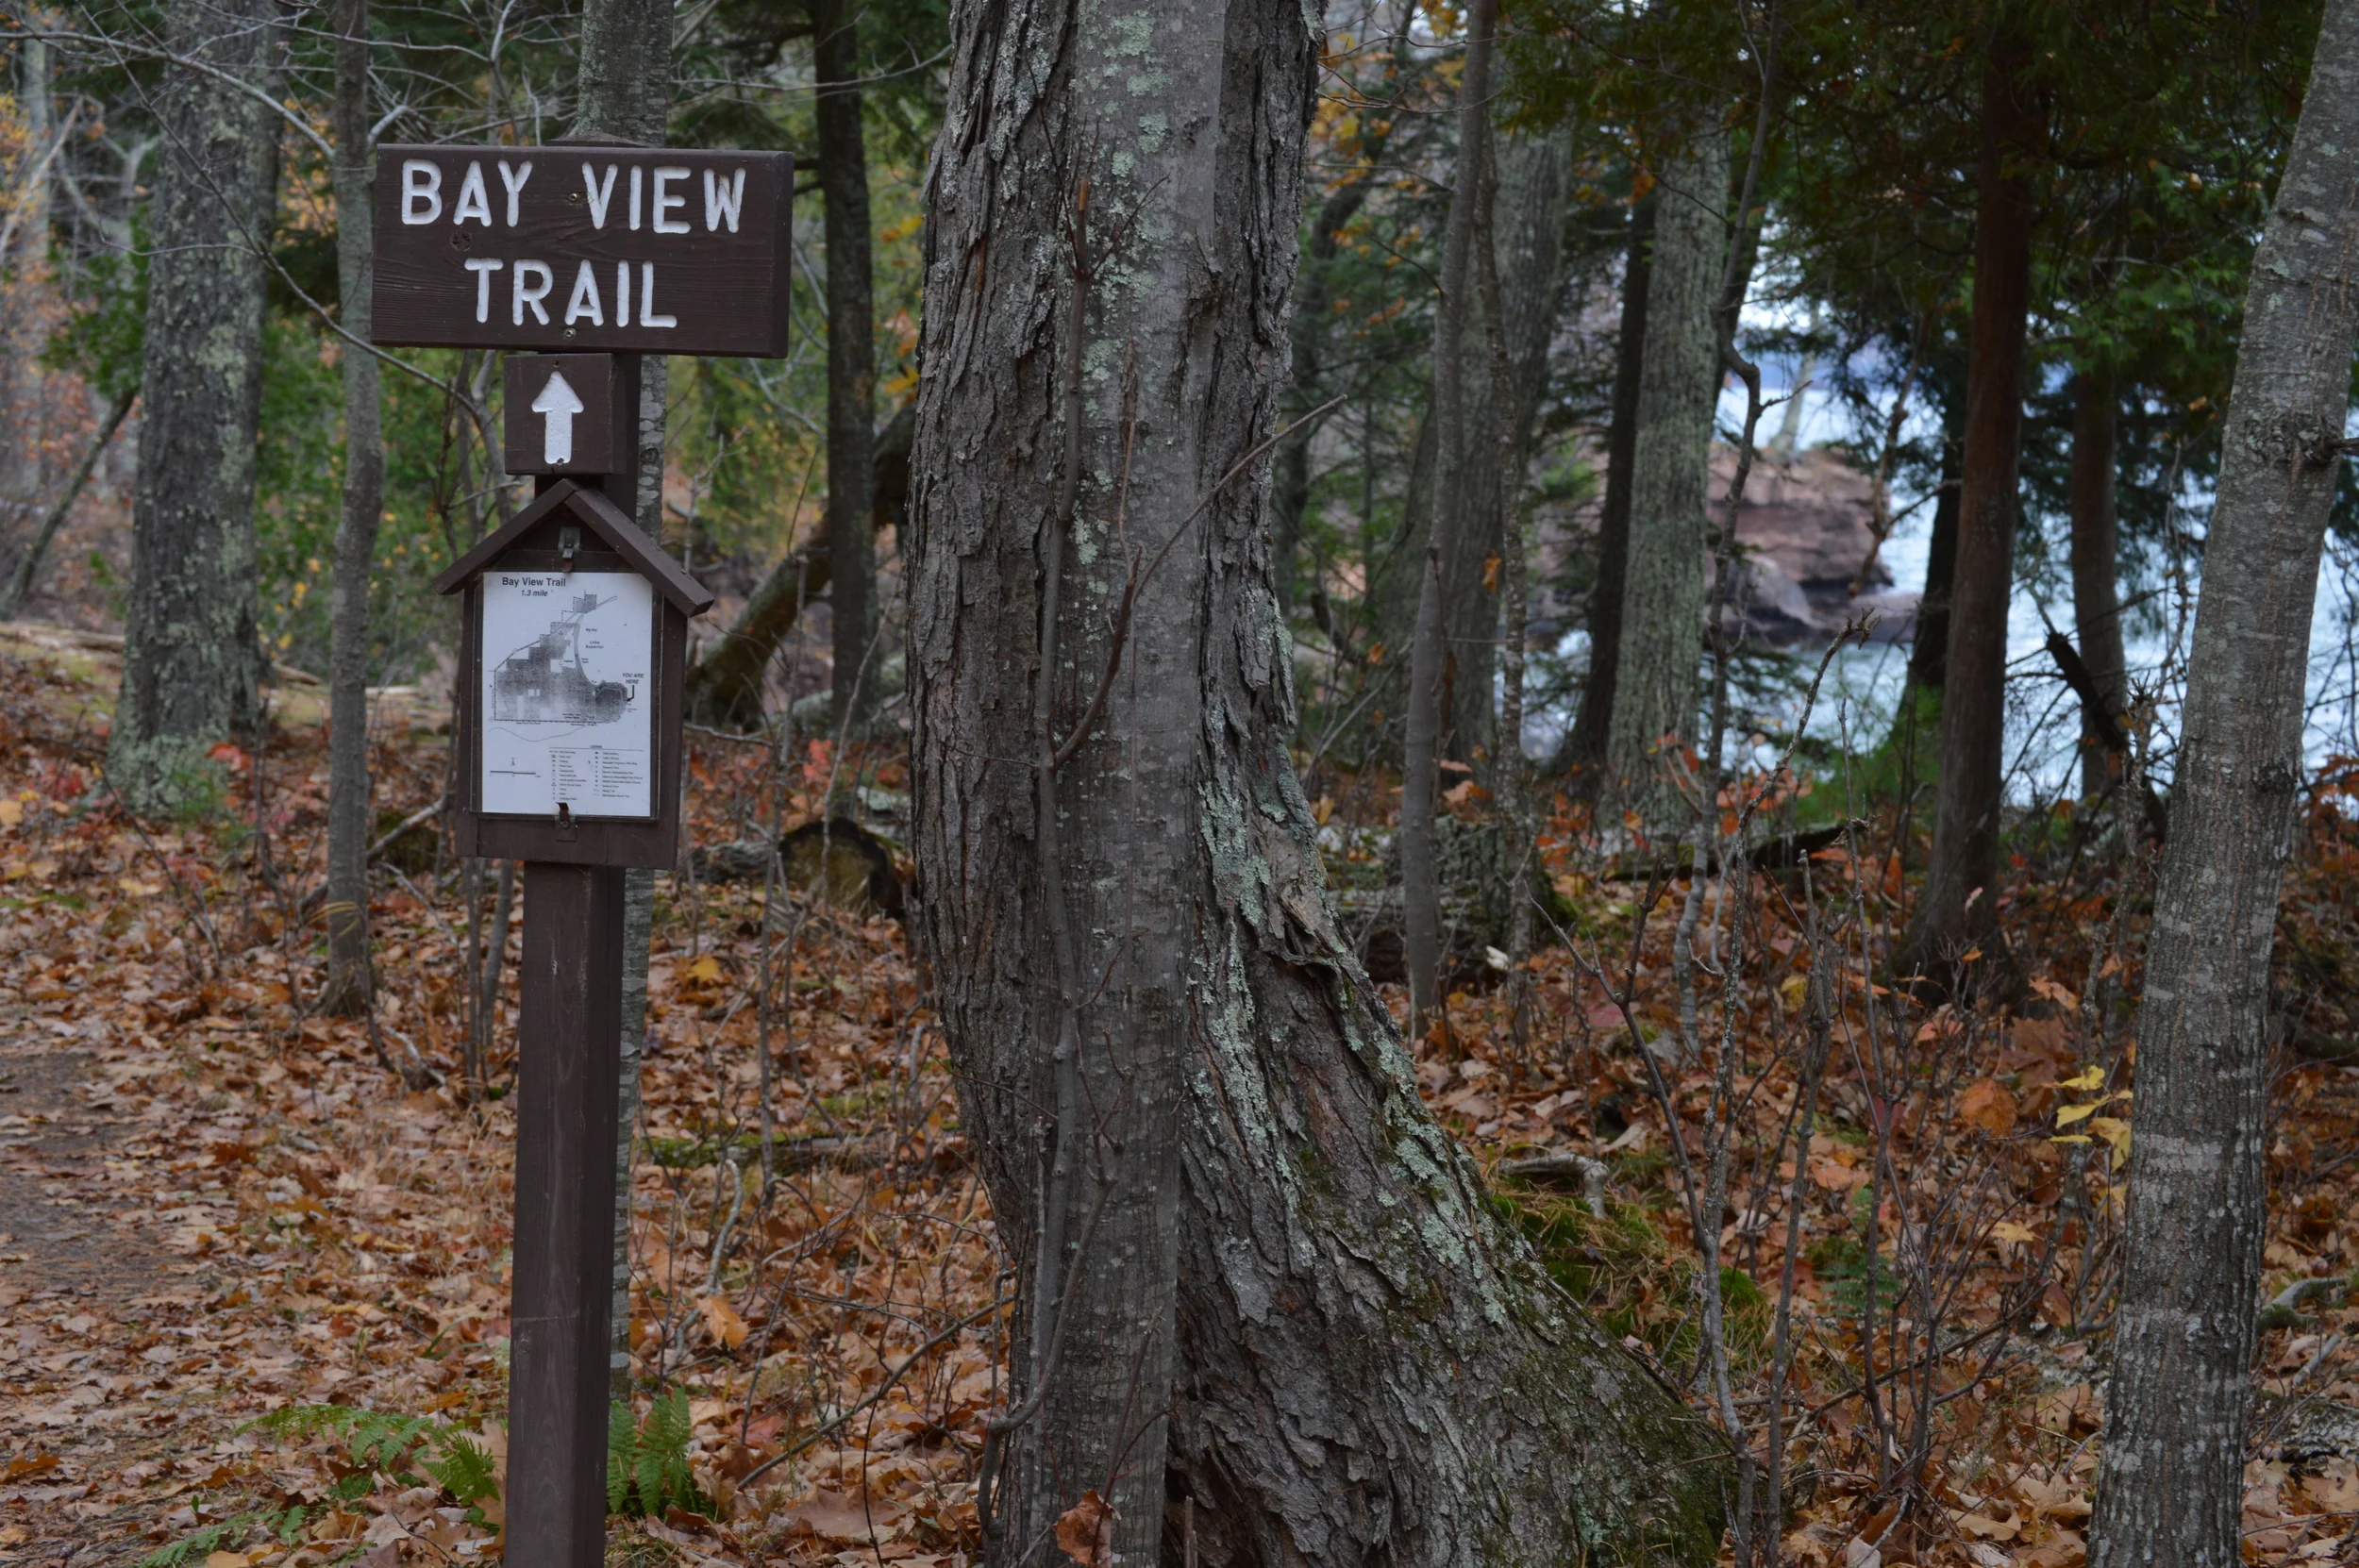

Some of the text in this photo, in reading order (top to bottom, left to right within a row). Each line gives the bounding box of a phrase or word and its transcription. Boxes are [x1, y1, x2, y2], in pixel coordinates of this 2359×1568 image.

[401, 158, 746, 235] BAY VIEW
[463, 259, 678, 328] TRAIL
[502, 576, 566, 588] Bay View Trail
